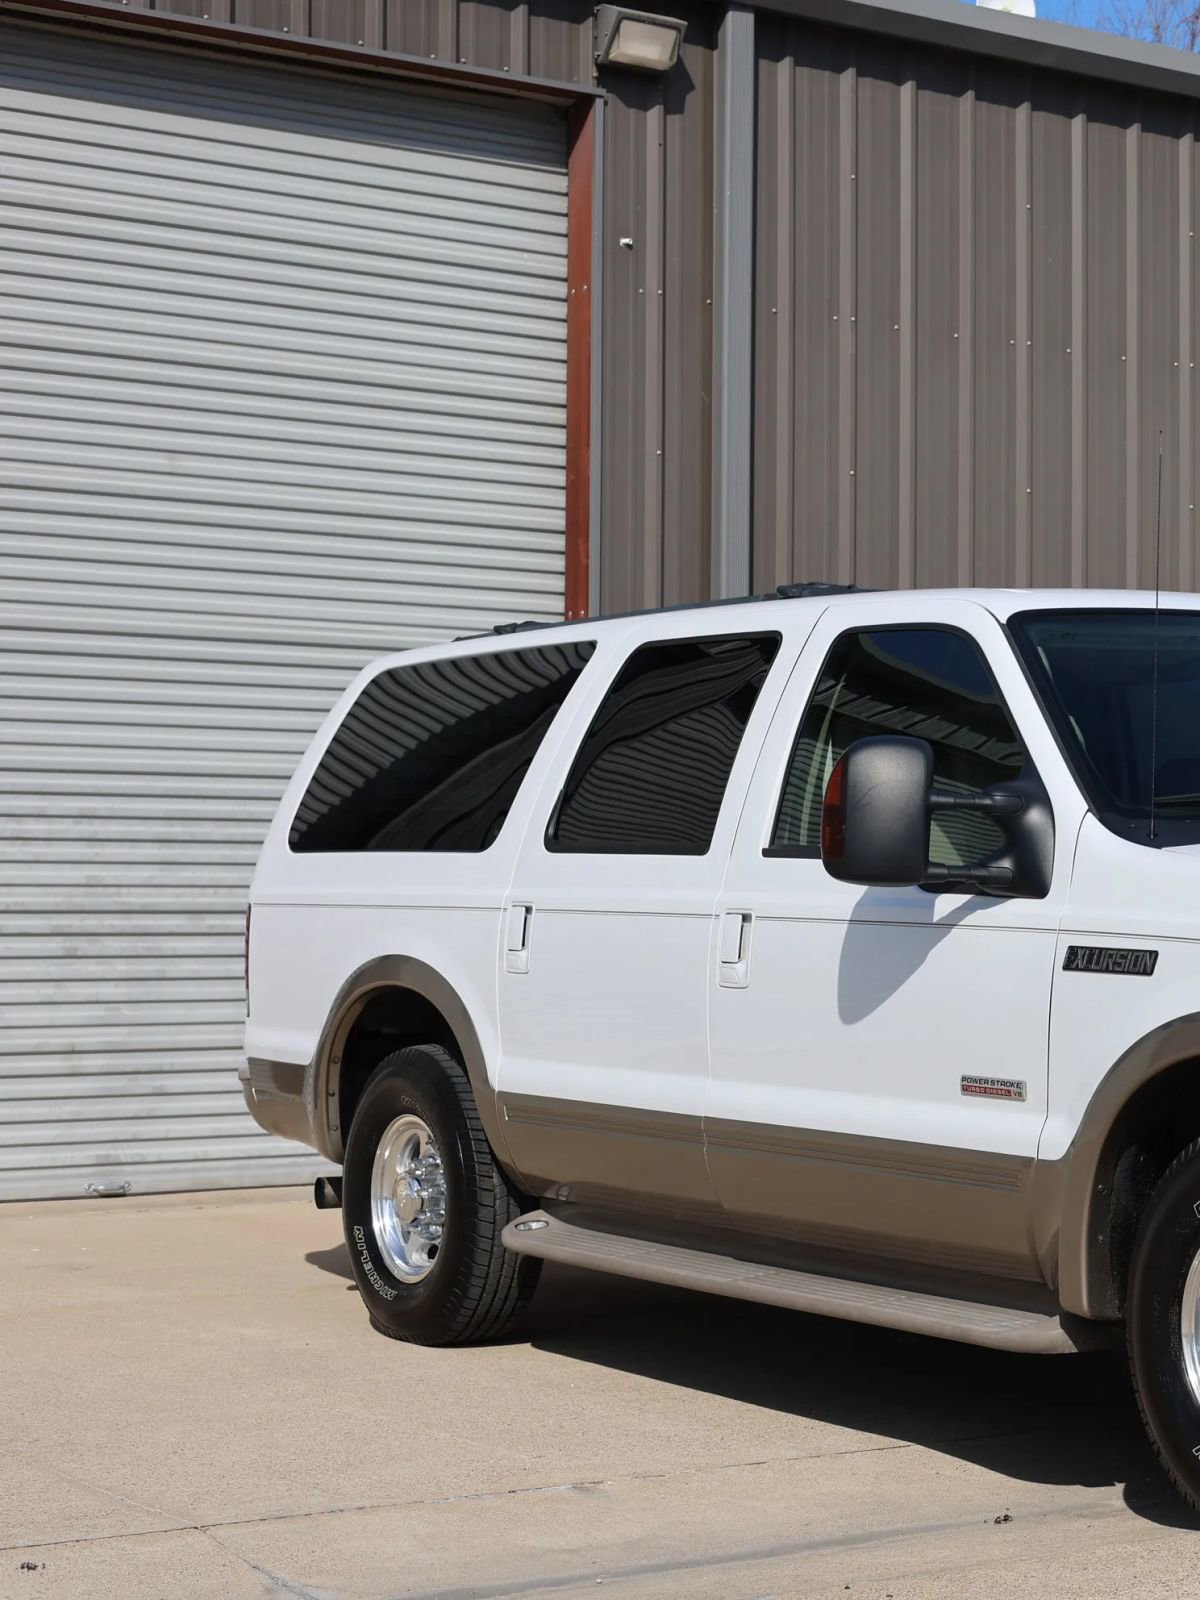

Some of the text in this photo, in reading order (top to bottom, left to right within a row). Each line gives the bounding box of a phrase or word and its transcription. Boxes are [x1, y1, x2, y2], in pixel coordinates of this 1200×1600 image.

[961, 1076, 1023, 1089] POWER STROKE
[354, 1225, 398, 1301] MICHELIN
